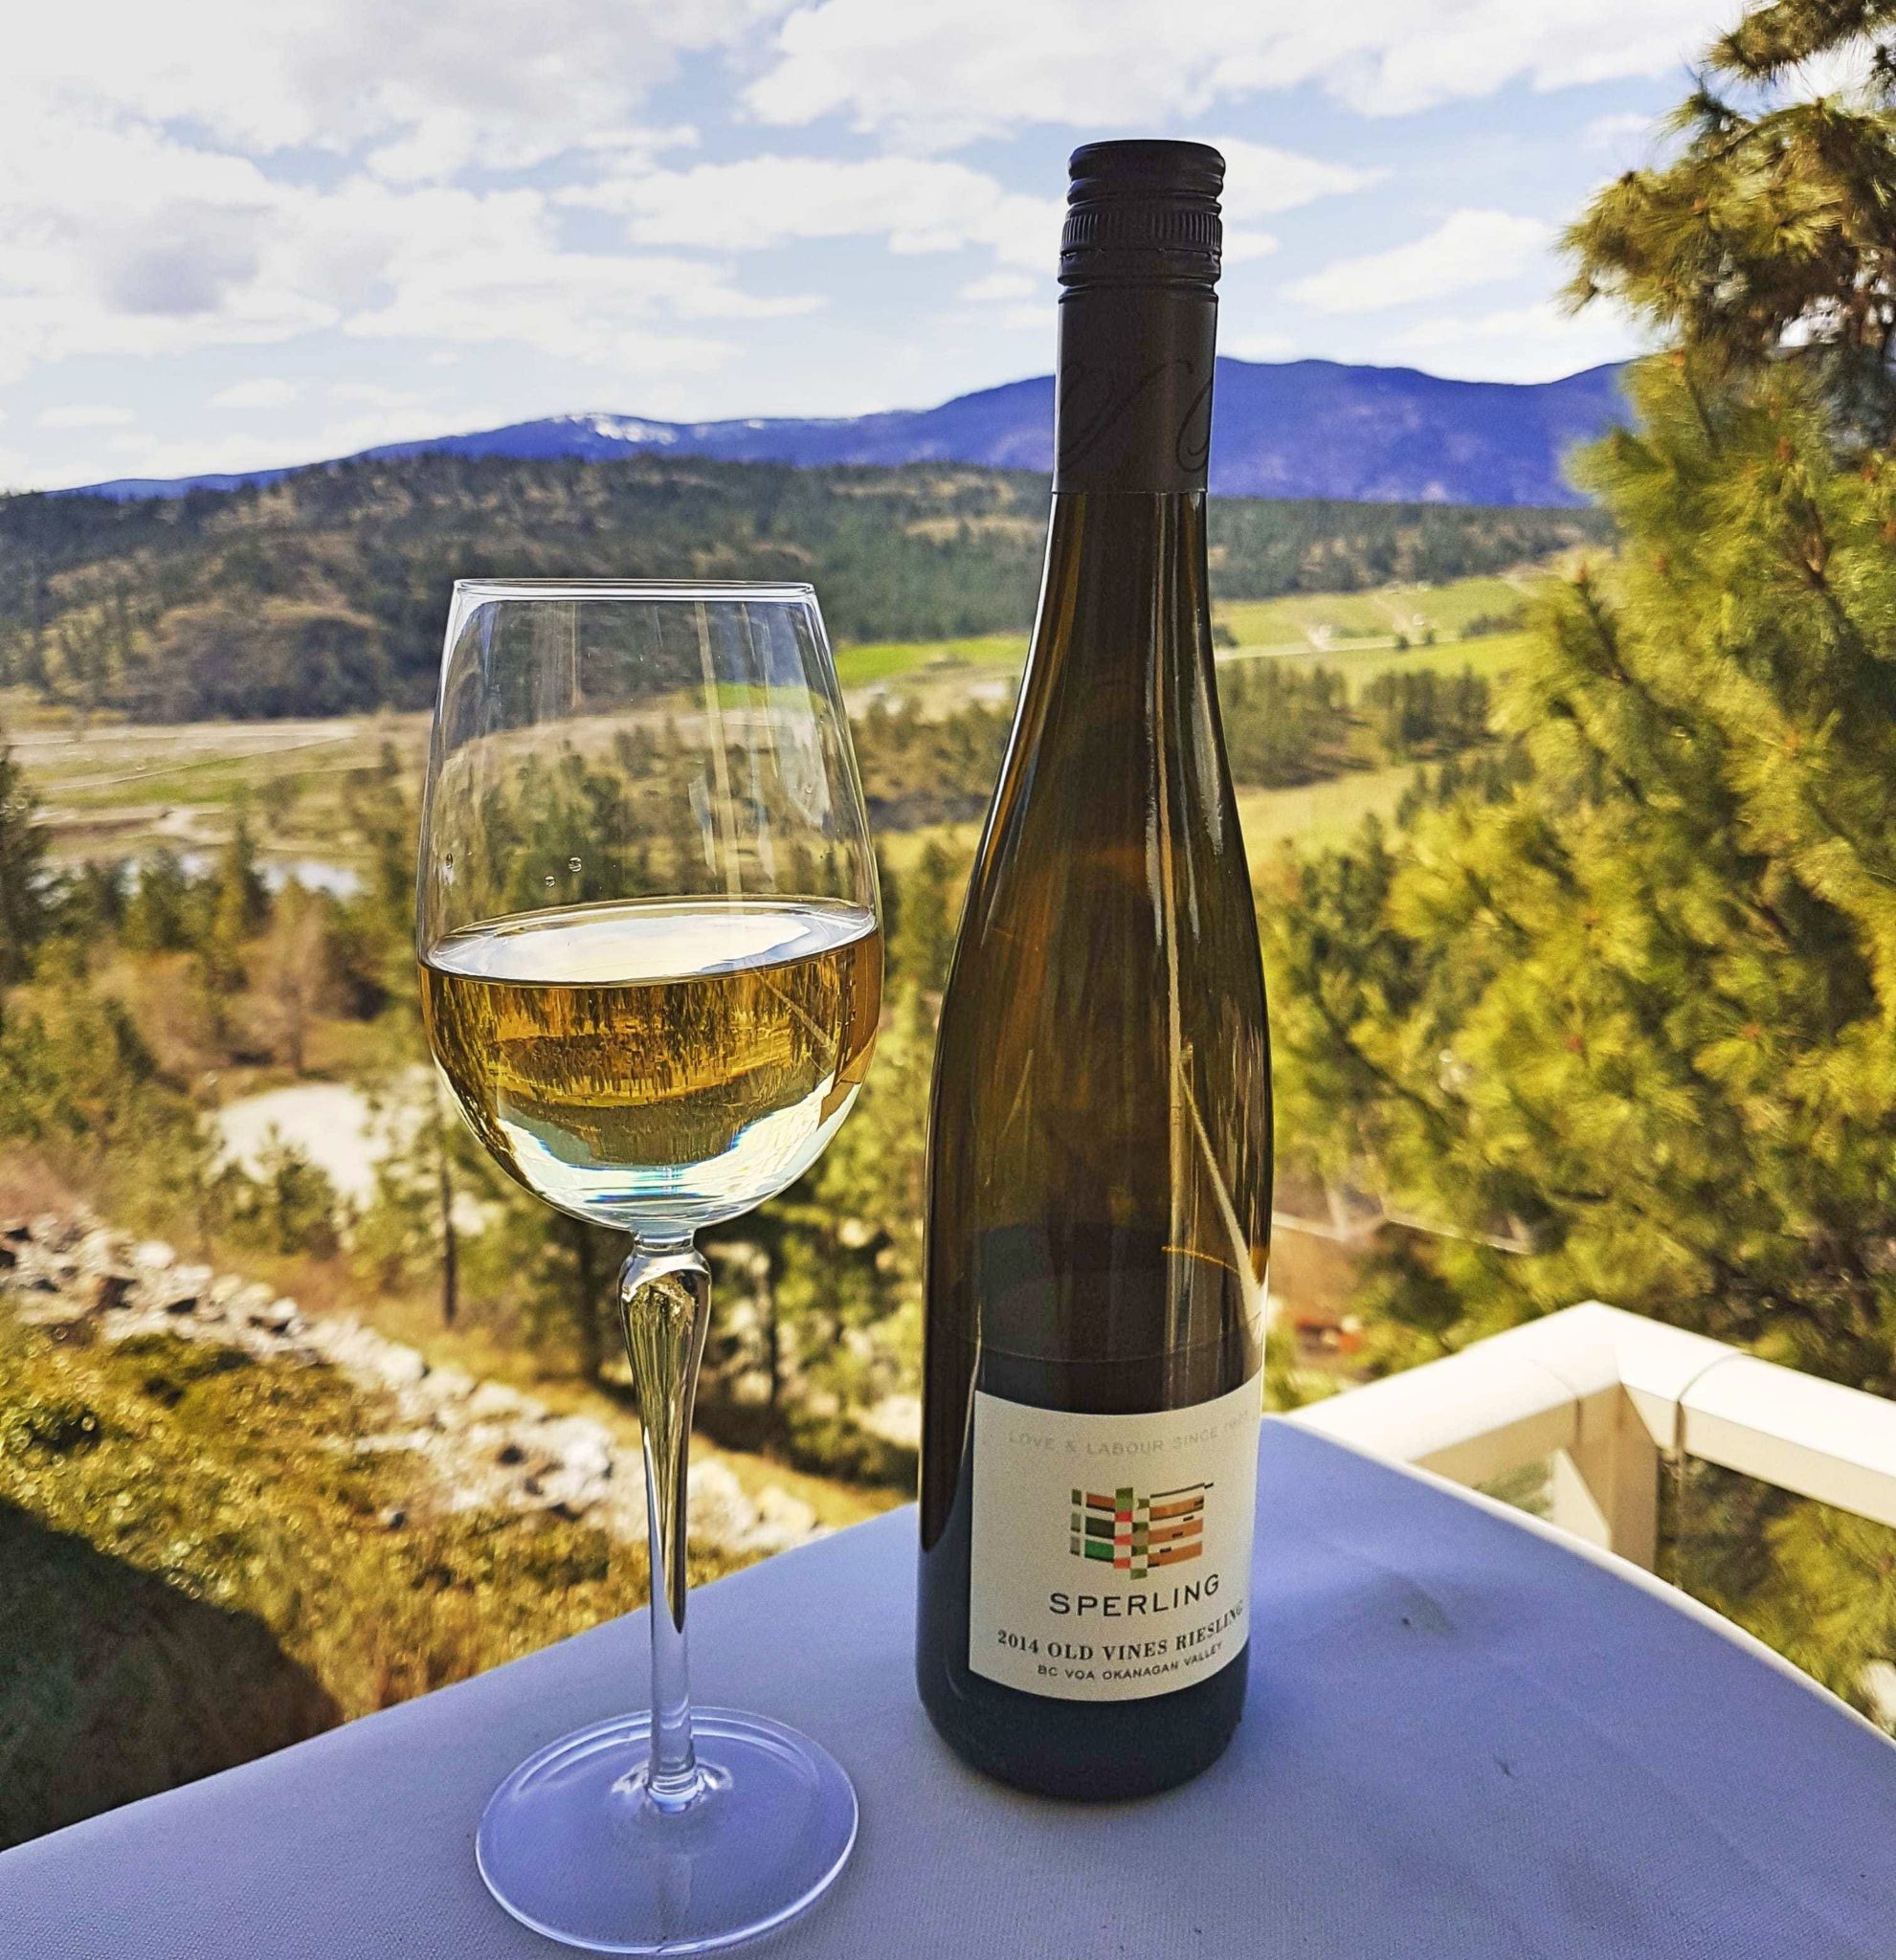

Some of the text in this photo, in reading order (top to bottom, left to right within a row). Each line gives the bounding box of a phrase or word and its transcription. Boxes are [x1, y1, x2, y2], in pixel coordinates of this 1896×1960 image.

[1009, 1430, 1055, 1451] LOVE
[1064, 1438, 1078, 1454] &
[1086, 1439, 1164, 1456] LABOUR
[1171, 1427, 1218, 1450] SINCE
[1049, 1573, 1219, 1616] SPERLING
[997, 1599, 1243, 1661] 2014 OLD VINES RIESLING
[1037, 1664, 1058, 1677] BC
[1102, 1660, 1179, 1681] OKANAGAN
[1184, 1641, 1223, 1666] VALLEY
